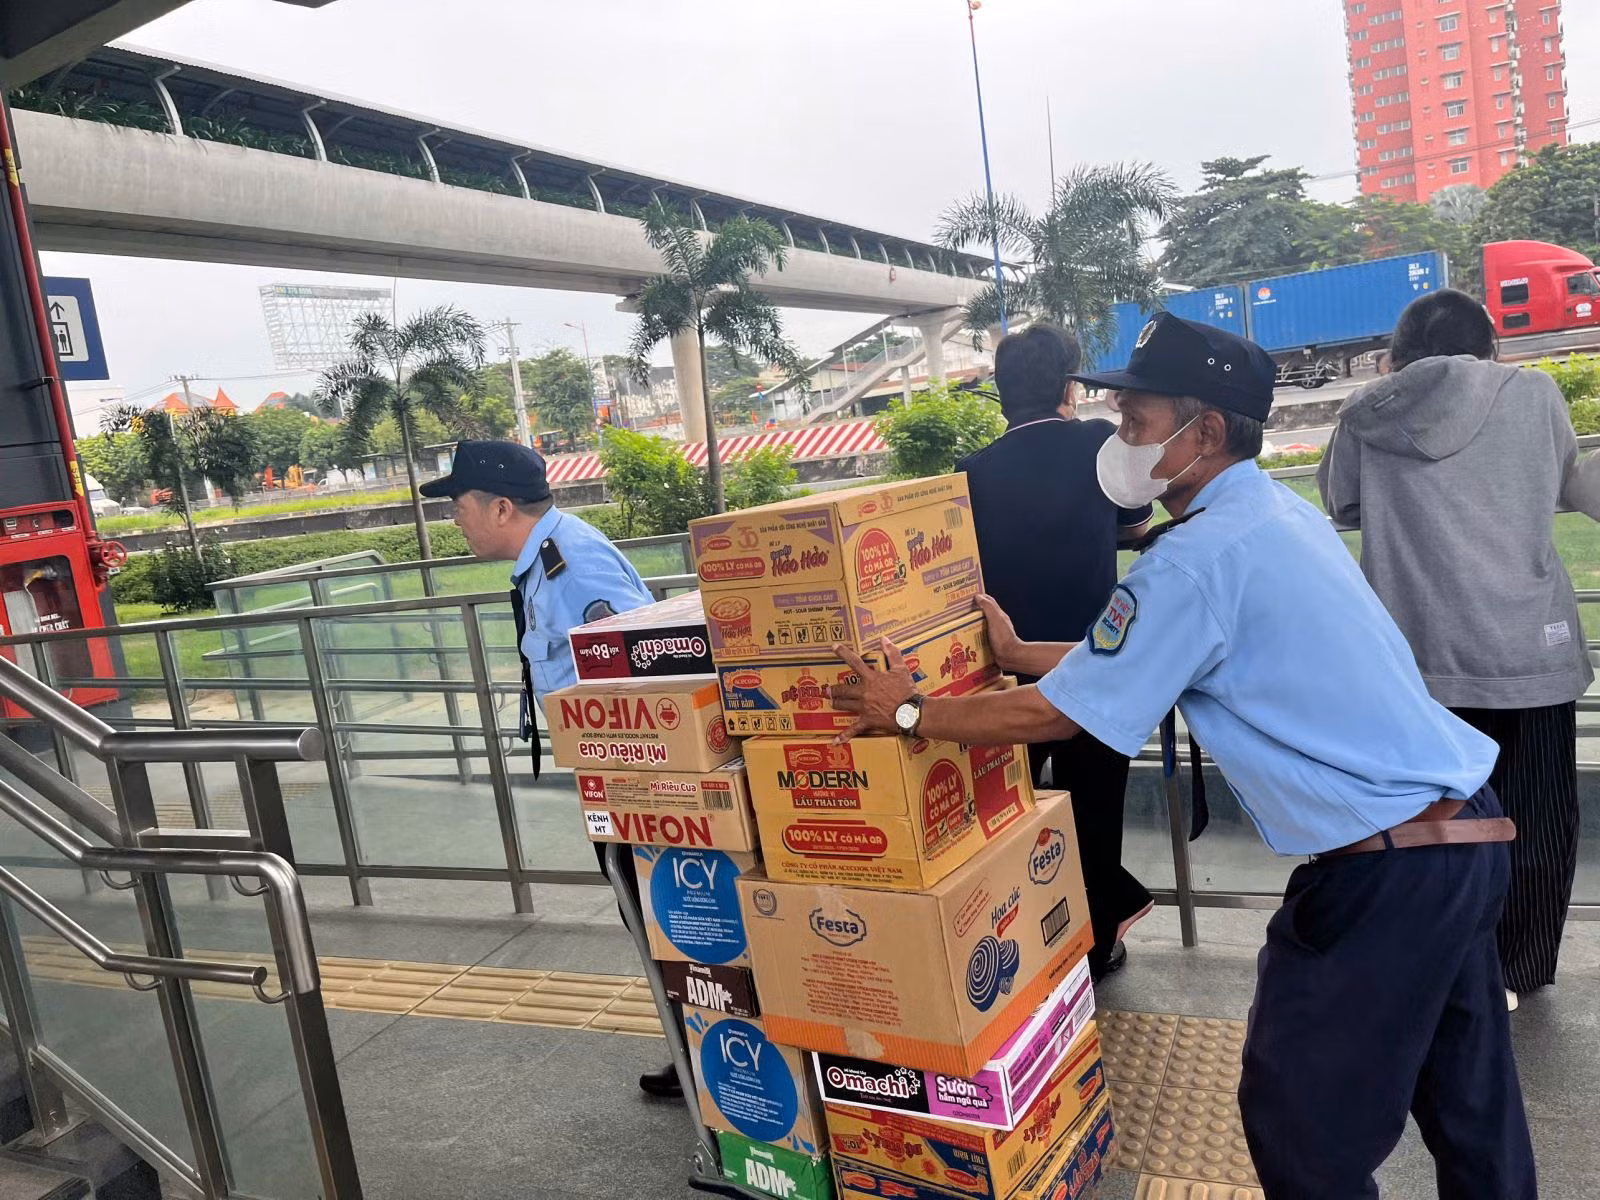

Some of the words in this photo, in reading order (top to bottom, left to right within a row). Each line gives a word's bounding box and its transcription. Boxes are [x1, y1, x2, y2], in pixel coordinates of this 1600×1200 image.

[881, 542, 890, 556] LY
[725, 560, 734, 571] LY
[638, 636, 706, 660] Omachi
[560, 698, 657, 730] VIFON
[579, 742, 608, 760] Cua
[609, 742, 645, 763] Riêu
[646, 744, 667, 764] Mì
[650, 781, 660, 792] Mì
[661, 781, 680, 792] Riêu
[680, 783, 697, 792] Cua
[777, 770, 870, 790] MODERN
[927, 782, 948, 805] 100%
[948, 772, 957, 792] LY
[584, 790, 604, 798] VIFON
[837, 797, 857, 807] TÔM
[587, 812, 609, 823] KÊNH
[929, 804, 939, 820] CÓ
[594, 826, 606, 834] MT
[610, 812, 713, 847] VIFON
[788, 828, 822, 843] 100%
[823, 830, 838, 843] LY
[840, 834, 853, 844] CÓ
[869, 836, 882, 844] QR
[1033, 842, 1060, 876] Festa
[672, 857, 718, 890] ICY
[816, 916, 859, 934] Festa
[991, 902, 1007, 930] Hoa
[720, 1033, 762, 1072] ICY
[826, 1066, 910, 1098] Omachi
[936, 1076, 977, 1096] Sườn
[938, 1093, 956, 1104] hầm
[956, 1096, 972, 1106] ngũ
[972, 1098, 988, 1108] quả
